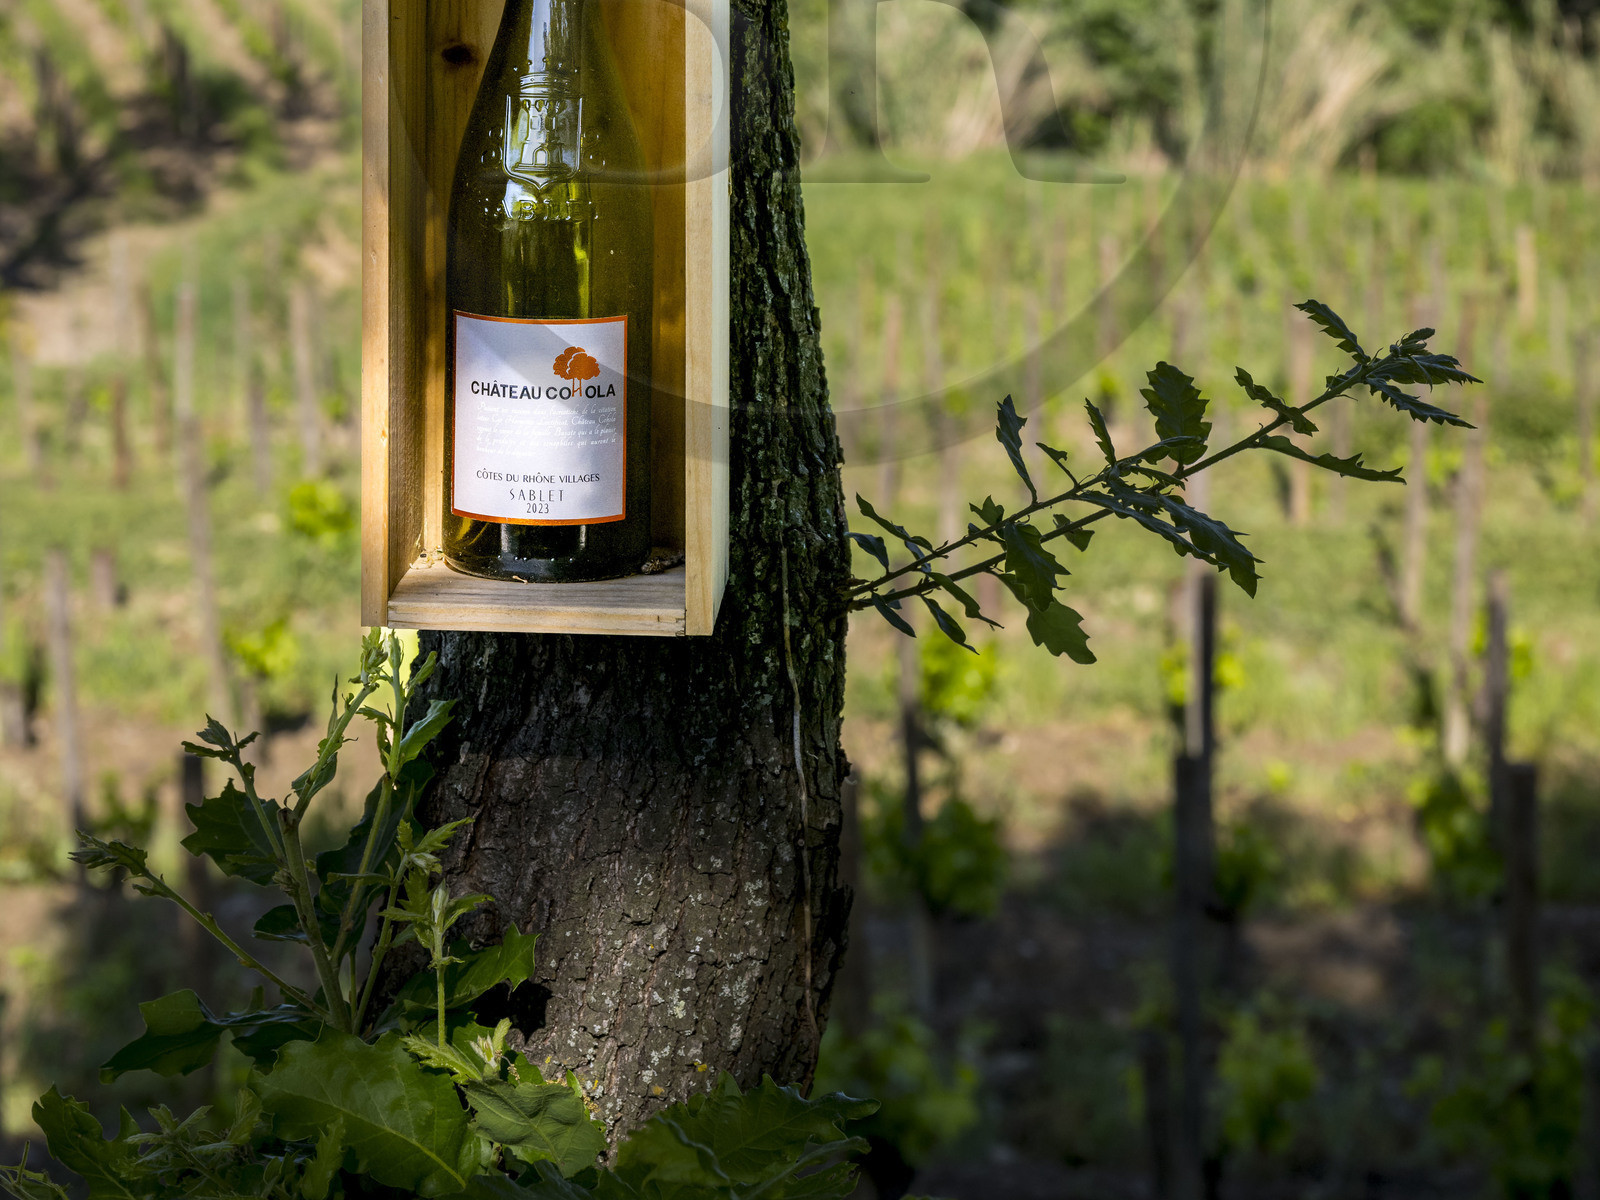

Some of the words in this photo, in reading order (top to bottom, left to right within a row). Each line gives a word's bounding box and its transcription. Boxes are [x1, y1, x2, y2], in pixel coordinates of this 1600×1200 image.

[471, 380, 541, 400] CHÂTEAU
[571, 415, 596, 426] Château
[476, 468, 503, 481] CÔTES
[505, 473, 520, 483] DU
[522, 472, 555, 484] RHÔNE
[559, 473, 600, 483] VILLAGES
[509, 488, 565, 502] SABLET
[526, 503, 550, 514] 2023
